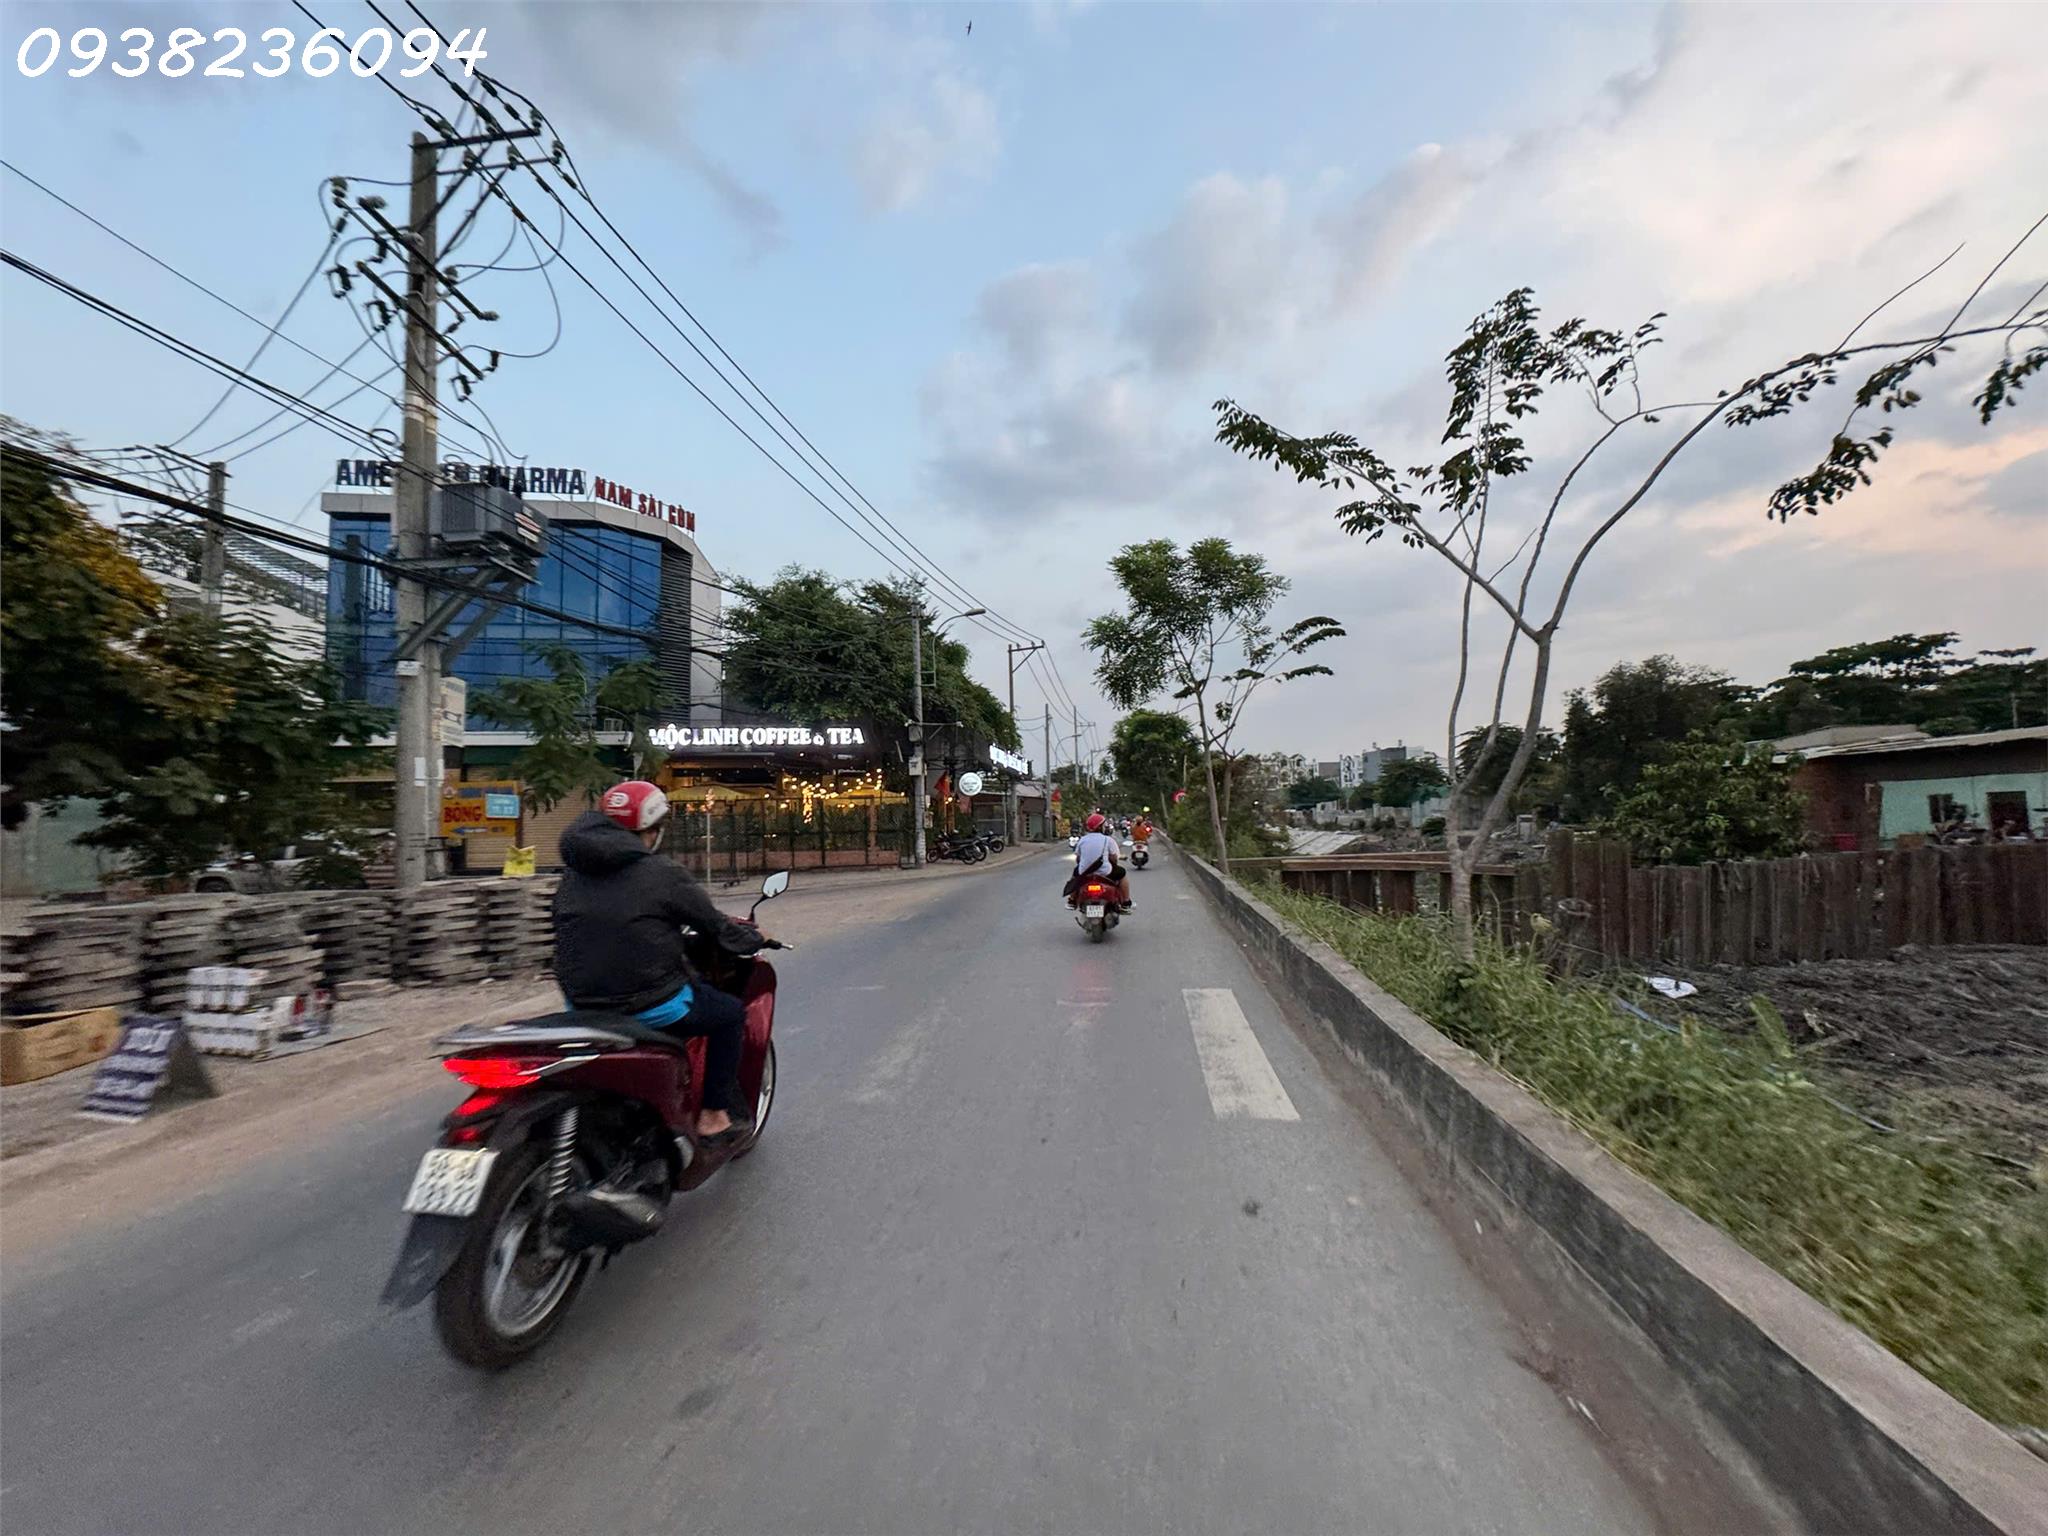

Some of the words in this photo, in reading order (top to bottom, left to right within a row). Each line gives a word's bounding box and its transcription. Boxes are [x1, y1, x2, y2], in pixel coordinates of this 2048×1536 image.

[595, 476, 632, 509] NAM
[648, 723, 692, 750] MỘC
[740, 727, 812, 745] COFFEE
[826, 728, 865, 745] TEA
